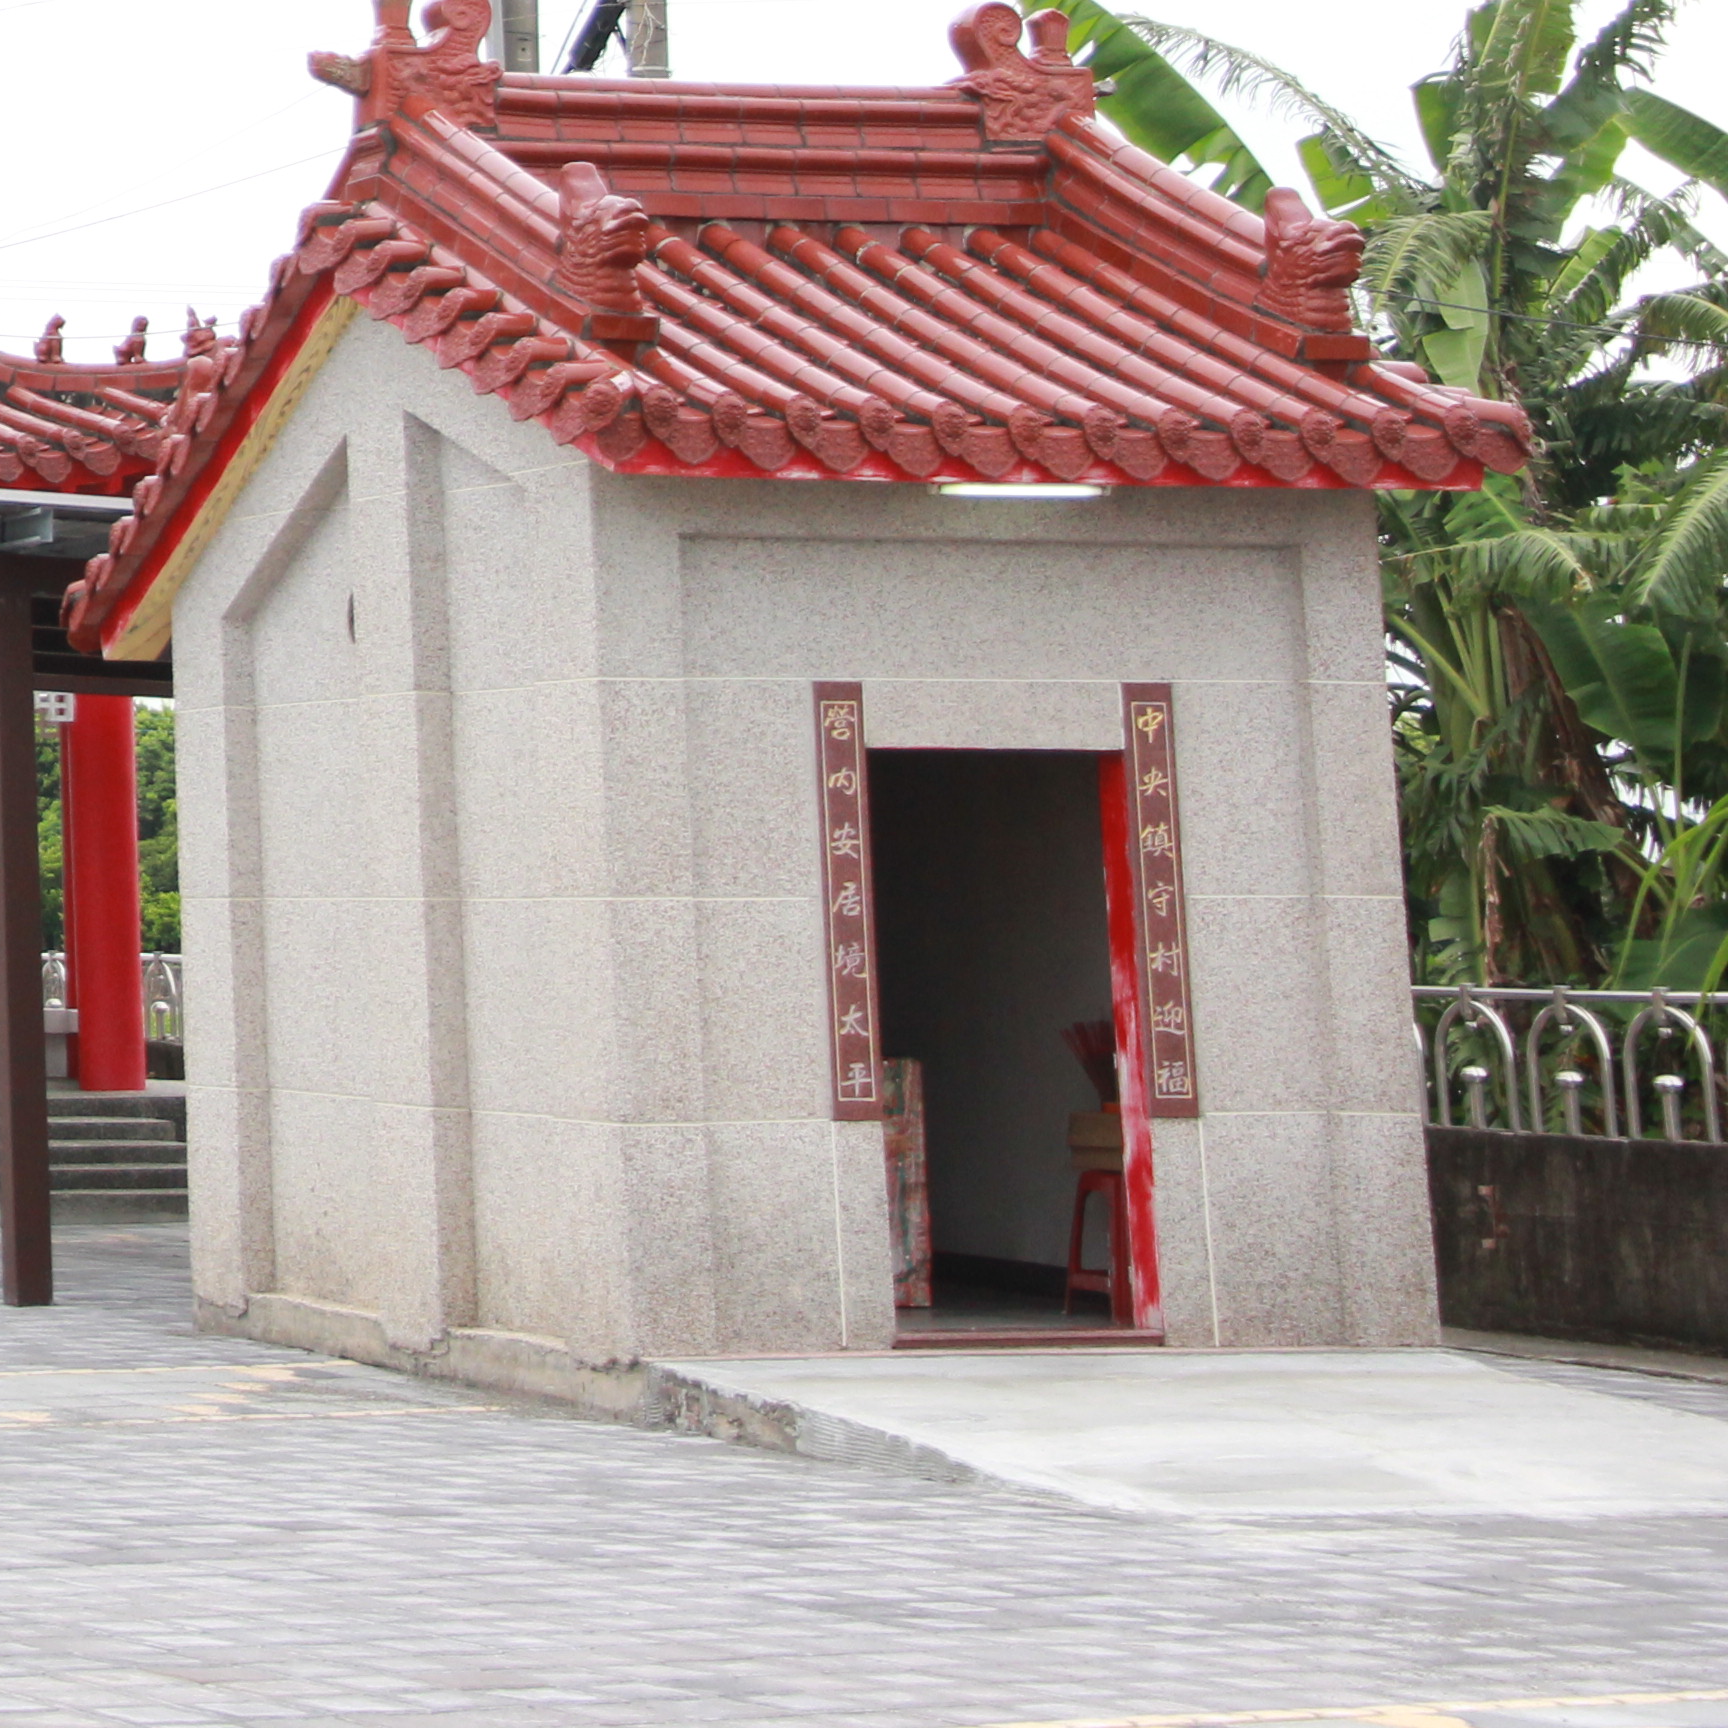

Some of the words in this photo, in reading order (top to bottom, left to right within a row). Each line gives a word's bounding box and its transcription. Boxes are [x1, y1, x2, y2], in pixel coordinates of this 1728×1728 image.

[1136, 707, 1190, 1094] 中央鎮守村迎福
